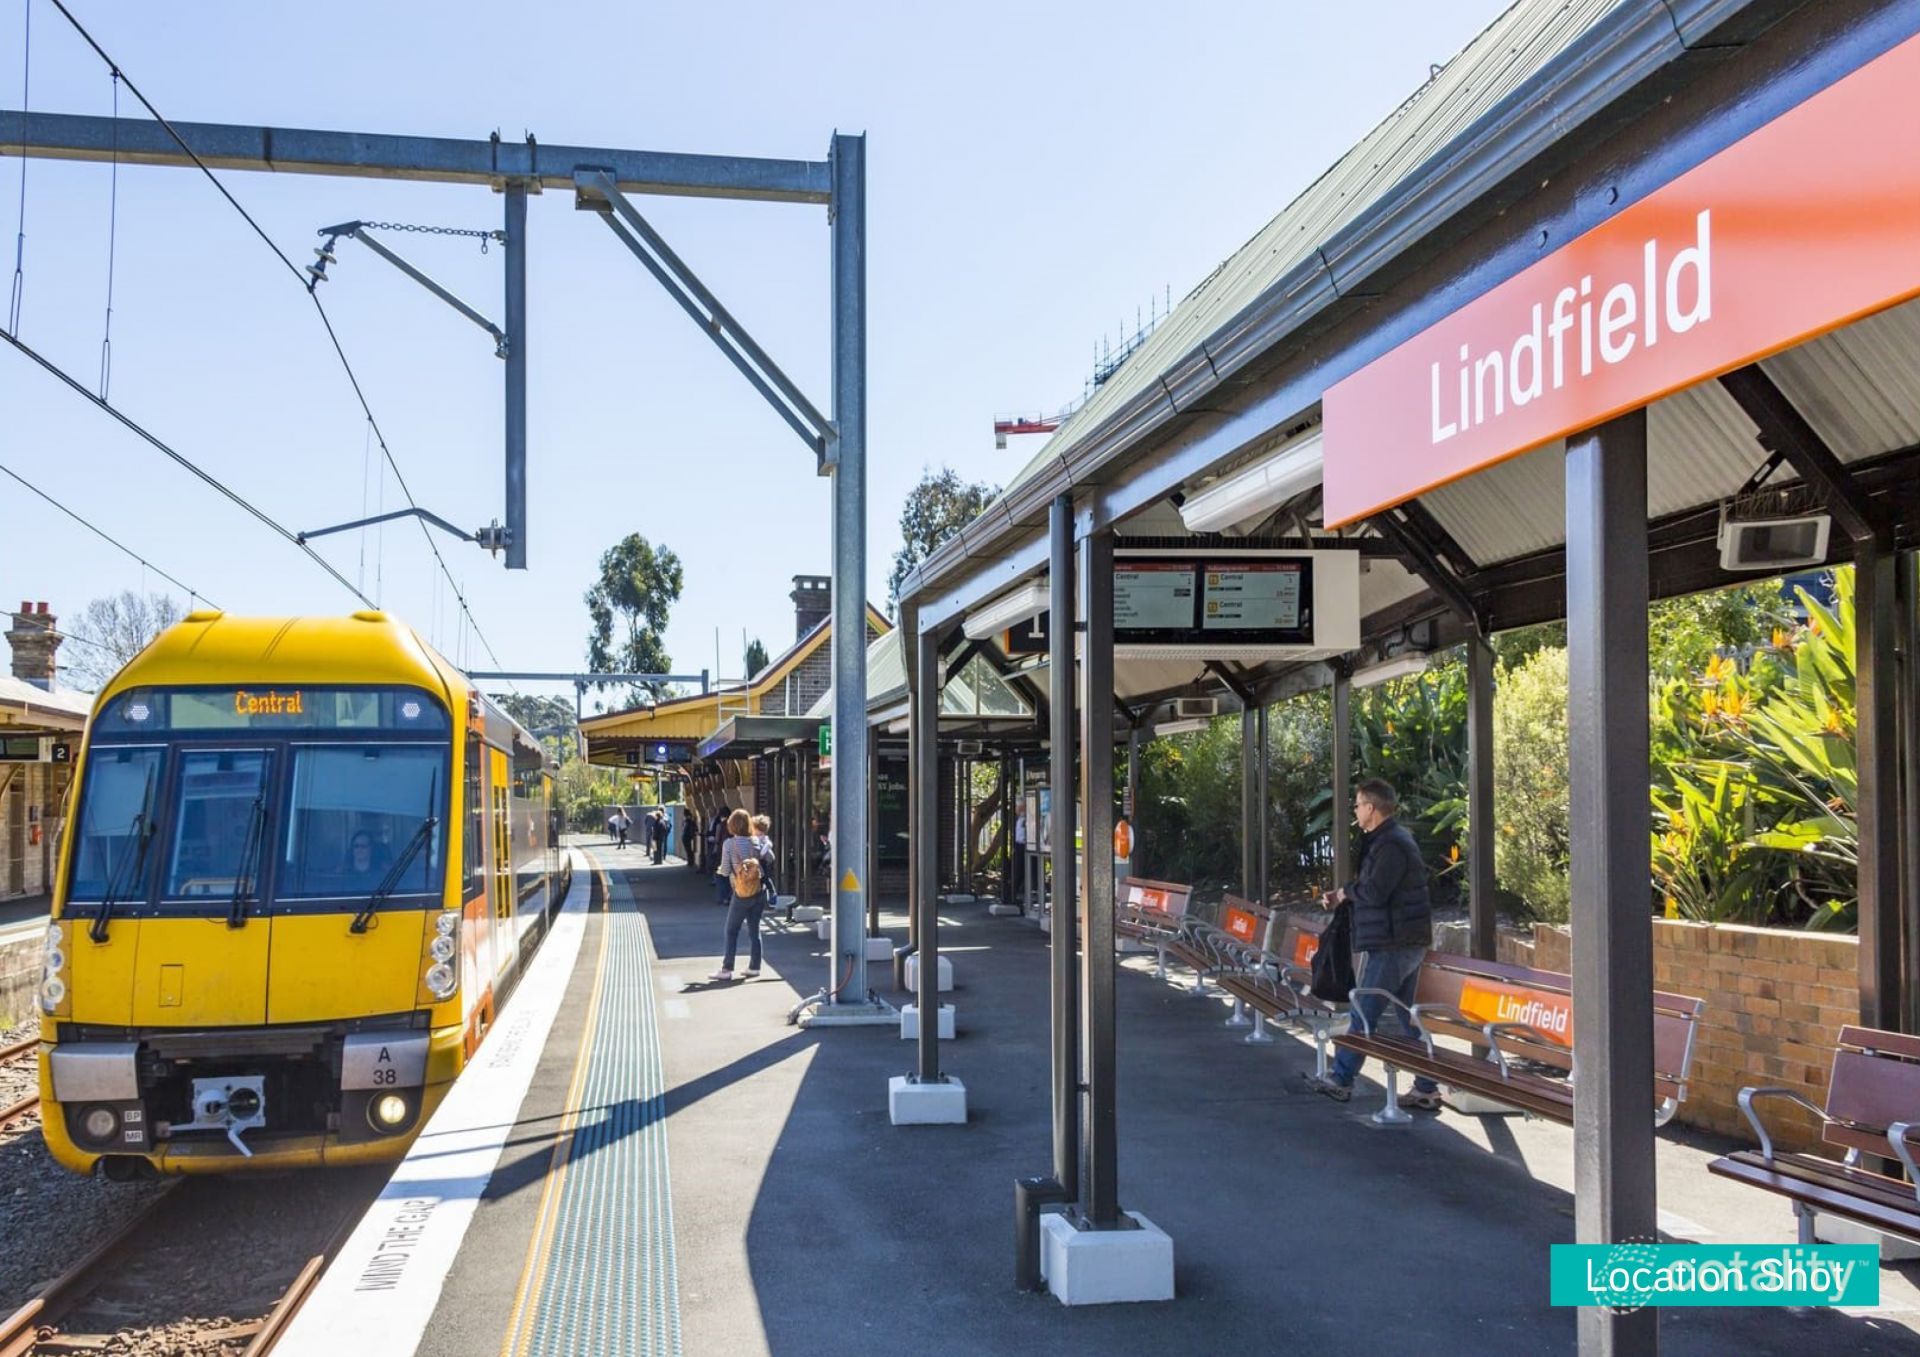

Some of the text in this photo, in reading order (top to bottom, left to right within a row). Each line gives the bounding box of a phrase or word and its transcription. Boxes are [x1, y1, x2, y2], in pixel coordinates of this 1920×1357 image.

[1431, 208, 1712, 444] Lindfield
[235, 690, 303, 715] Central
[56, 747, 65, 759] 2
[1496, 993, 1569, 1033] Lindfield
[378, 1046, 392, 1062] A
[373, 1069, 397, 1085] 38
[377, 1225, 426, 1252] THE
[352, 1252, 410, 1292] MIND
